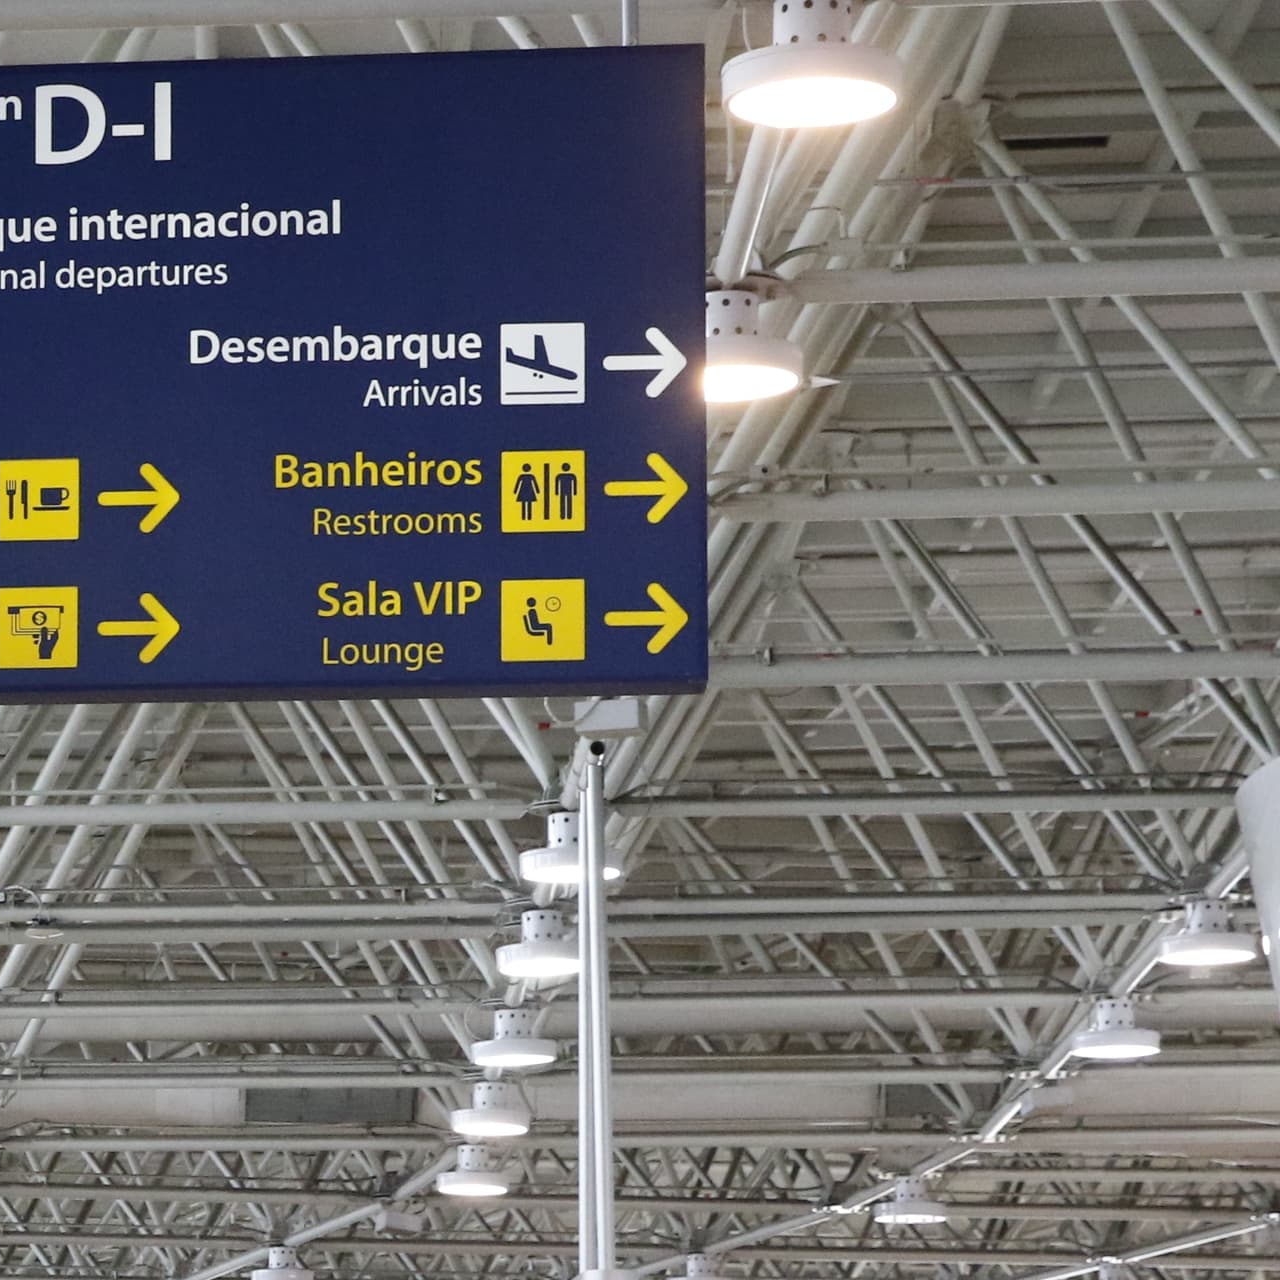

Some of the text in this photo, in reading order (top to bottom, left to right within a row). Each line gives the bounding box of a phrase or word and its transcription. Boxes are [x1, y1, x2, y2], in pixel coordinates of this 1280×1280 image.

[35, 81, 172, 165] D-I
[69, 199, 341, 242] internacional
[55, 258, 228, 295] departures
[189, 325, 483, 369] Desembarque
[363, 376, 483, 408] Arrivals
[275, 451, 482, 489] Banheiros
[313, 508, 482, 536] Restrooms
[317, 579, 482, 618] Sala VIP
[323, 637, 444, 672] Lounge
